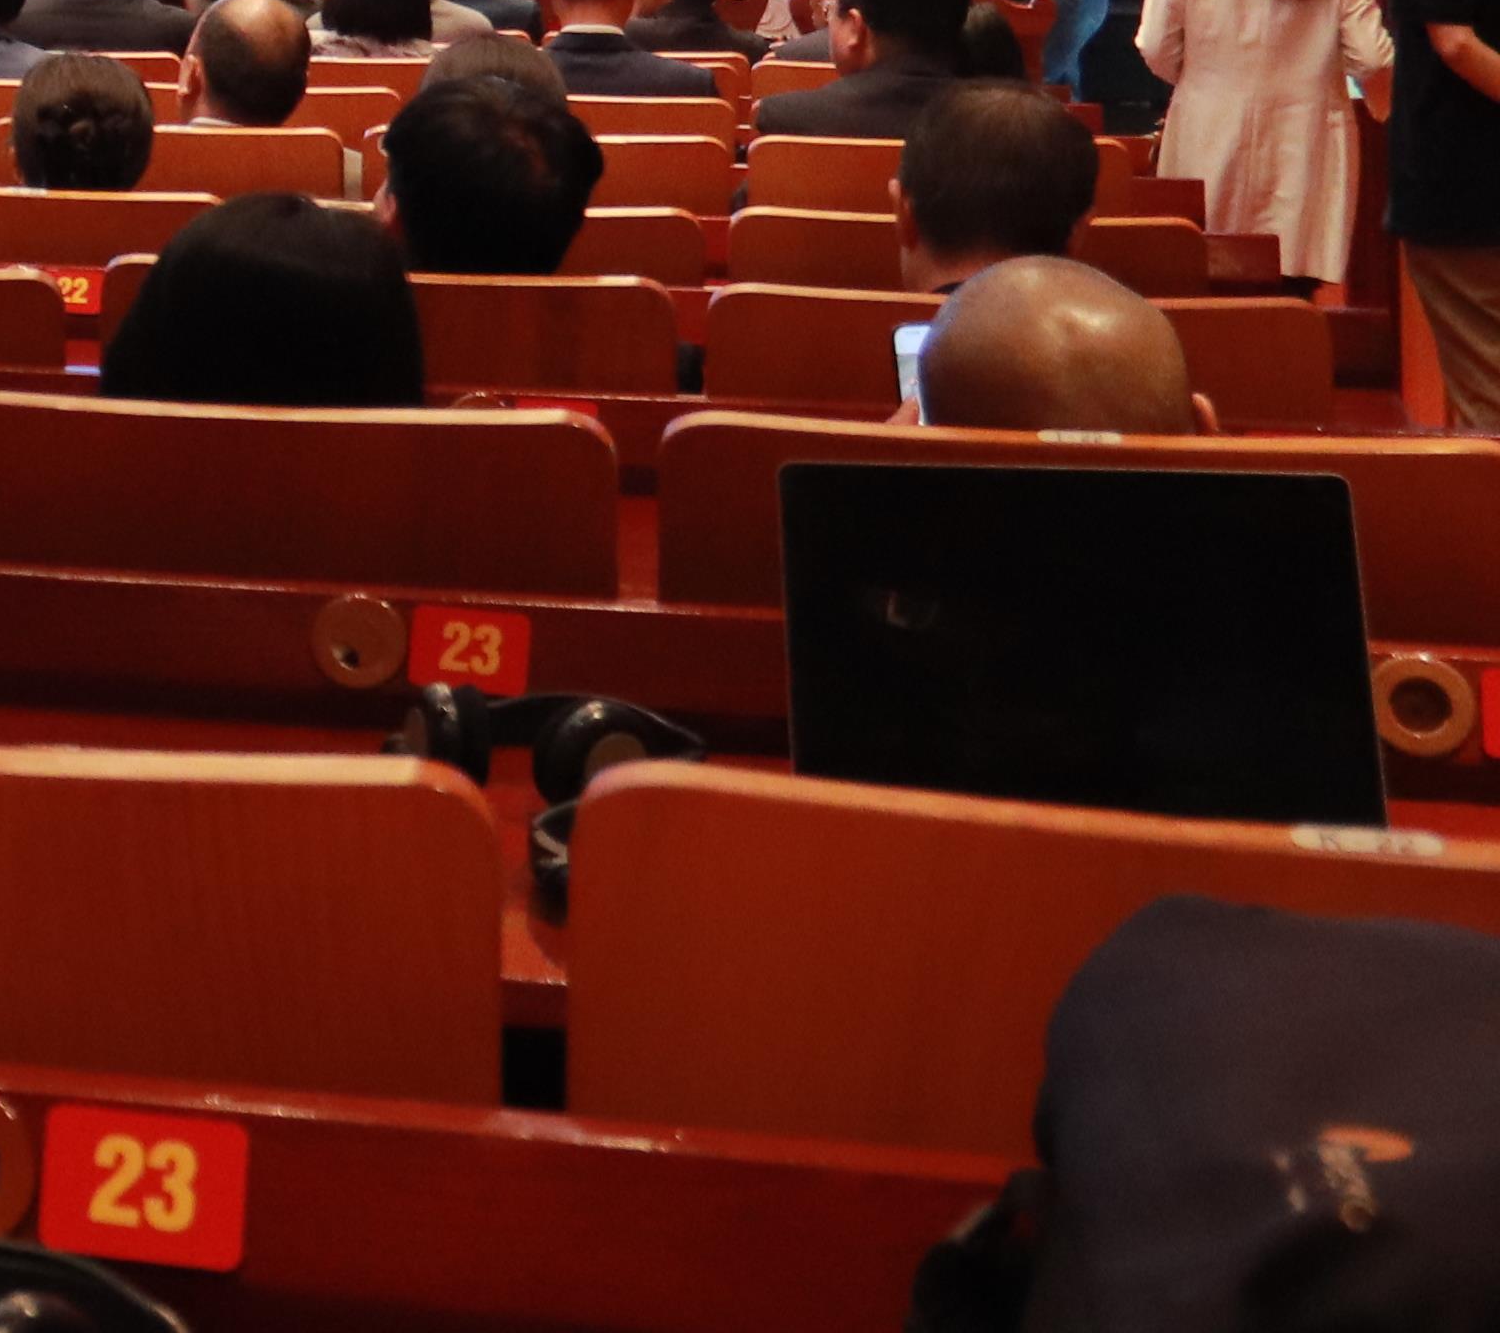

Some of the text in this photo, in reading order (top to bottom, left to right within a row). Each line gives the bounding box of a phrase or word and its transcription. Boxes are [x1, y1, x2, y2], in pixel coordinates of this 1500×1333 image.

[58, 276, 89, 304] 22
[438, 621, 504, 675] 23
[87, 1134, 199, 1232] 23
